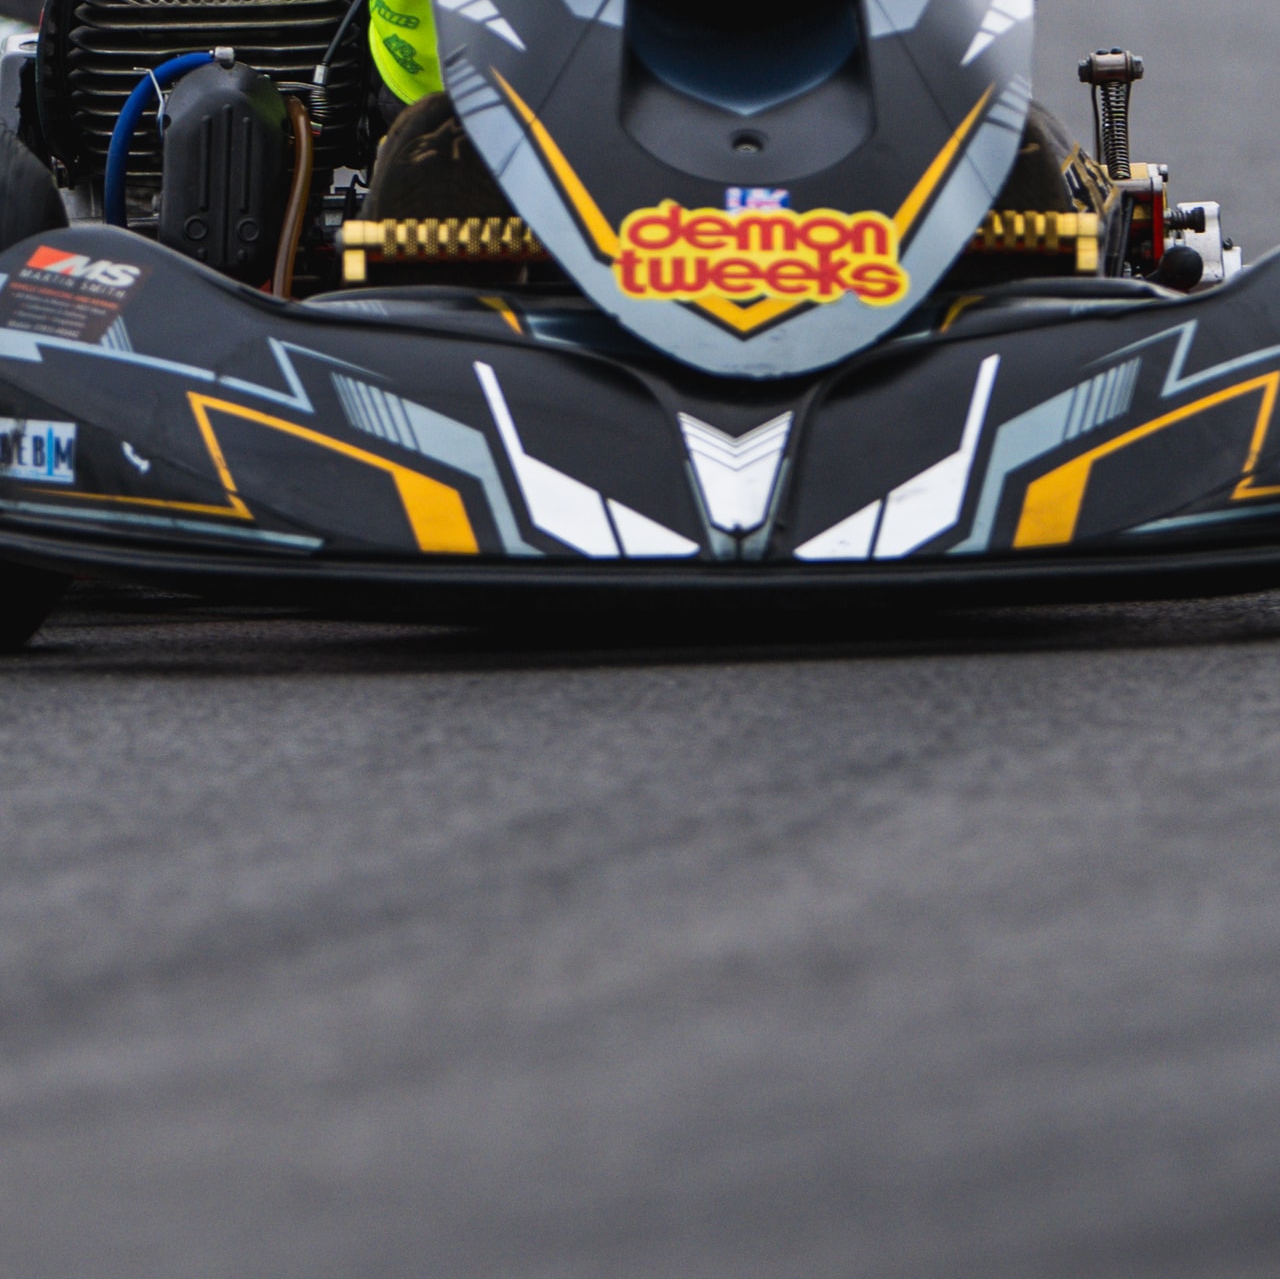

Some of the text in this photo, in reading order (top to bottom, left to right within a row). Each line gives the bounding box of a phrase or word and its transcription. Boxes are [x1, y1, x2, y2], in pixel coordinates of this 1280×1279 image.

[627, 206, 889, 256] demon
[20, 268, 76, 288] MARTIN
[80, 280, 127, 298] SMITH
[614, 248, 902, 298] tweeks
